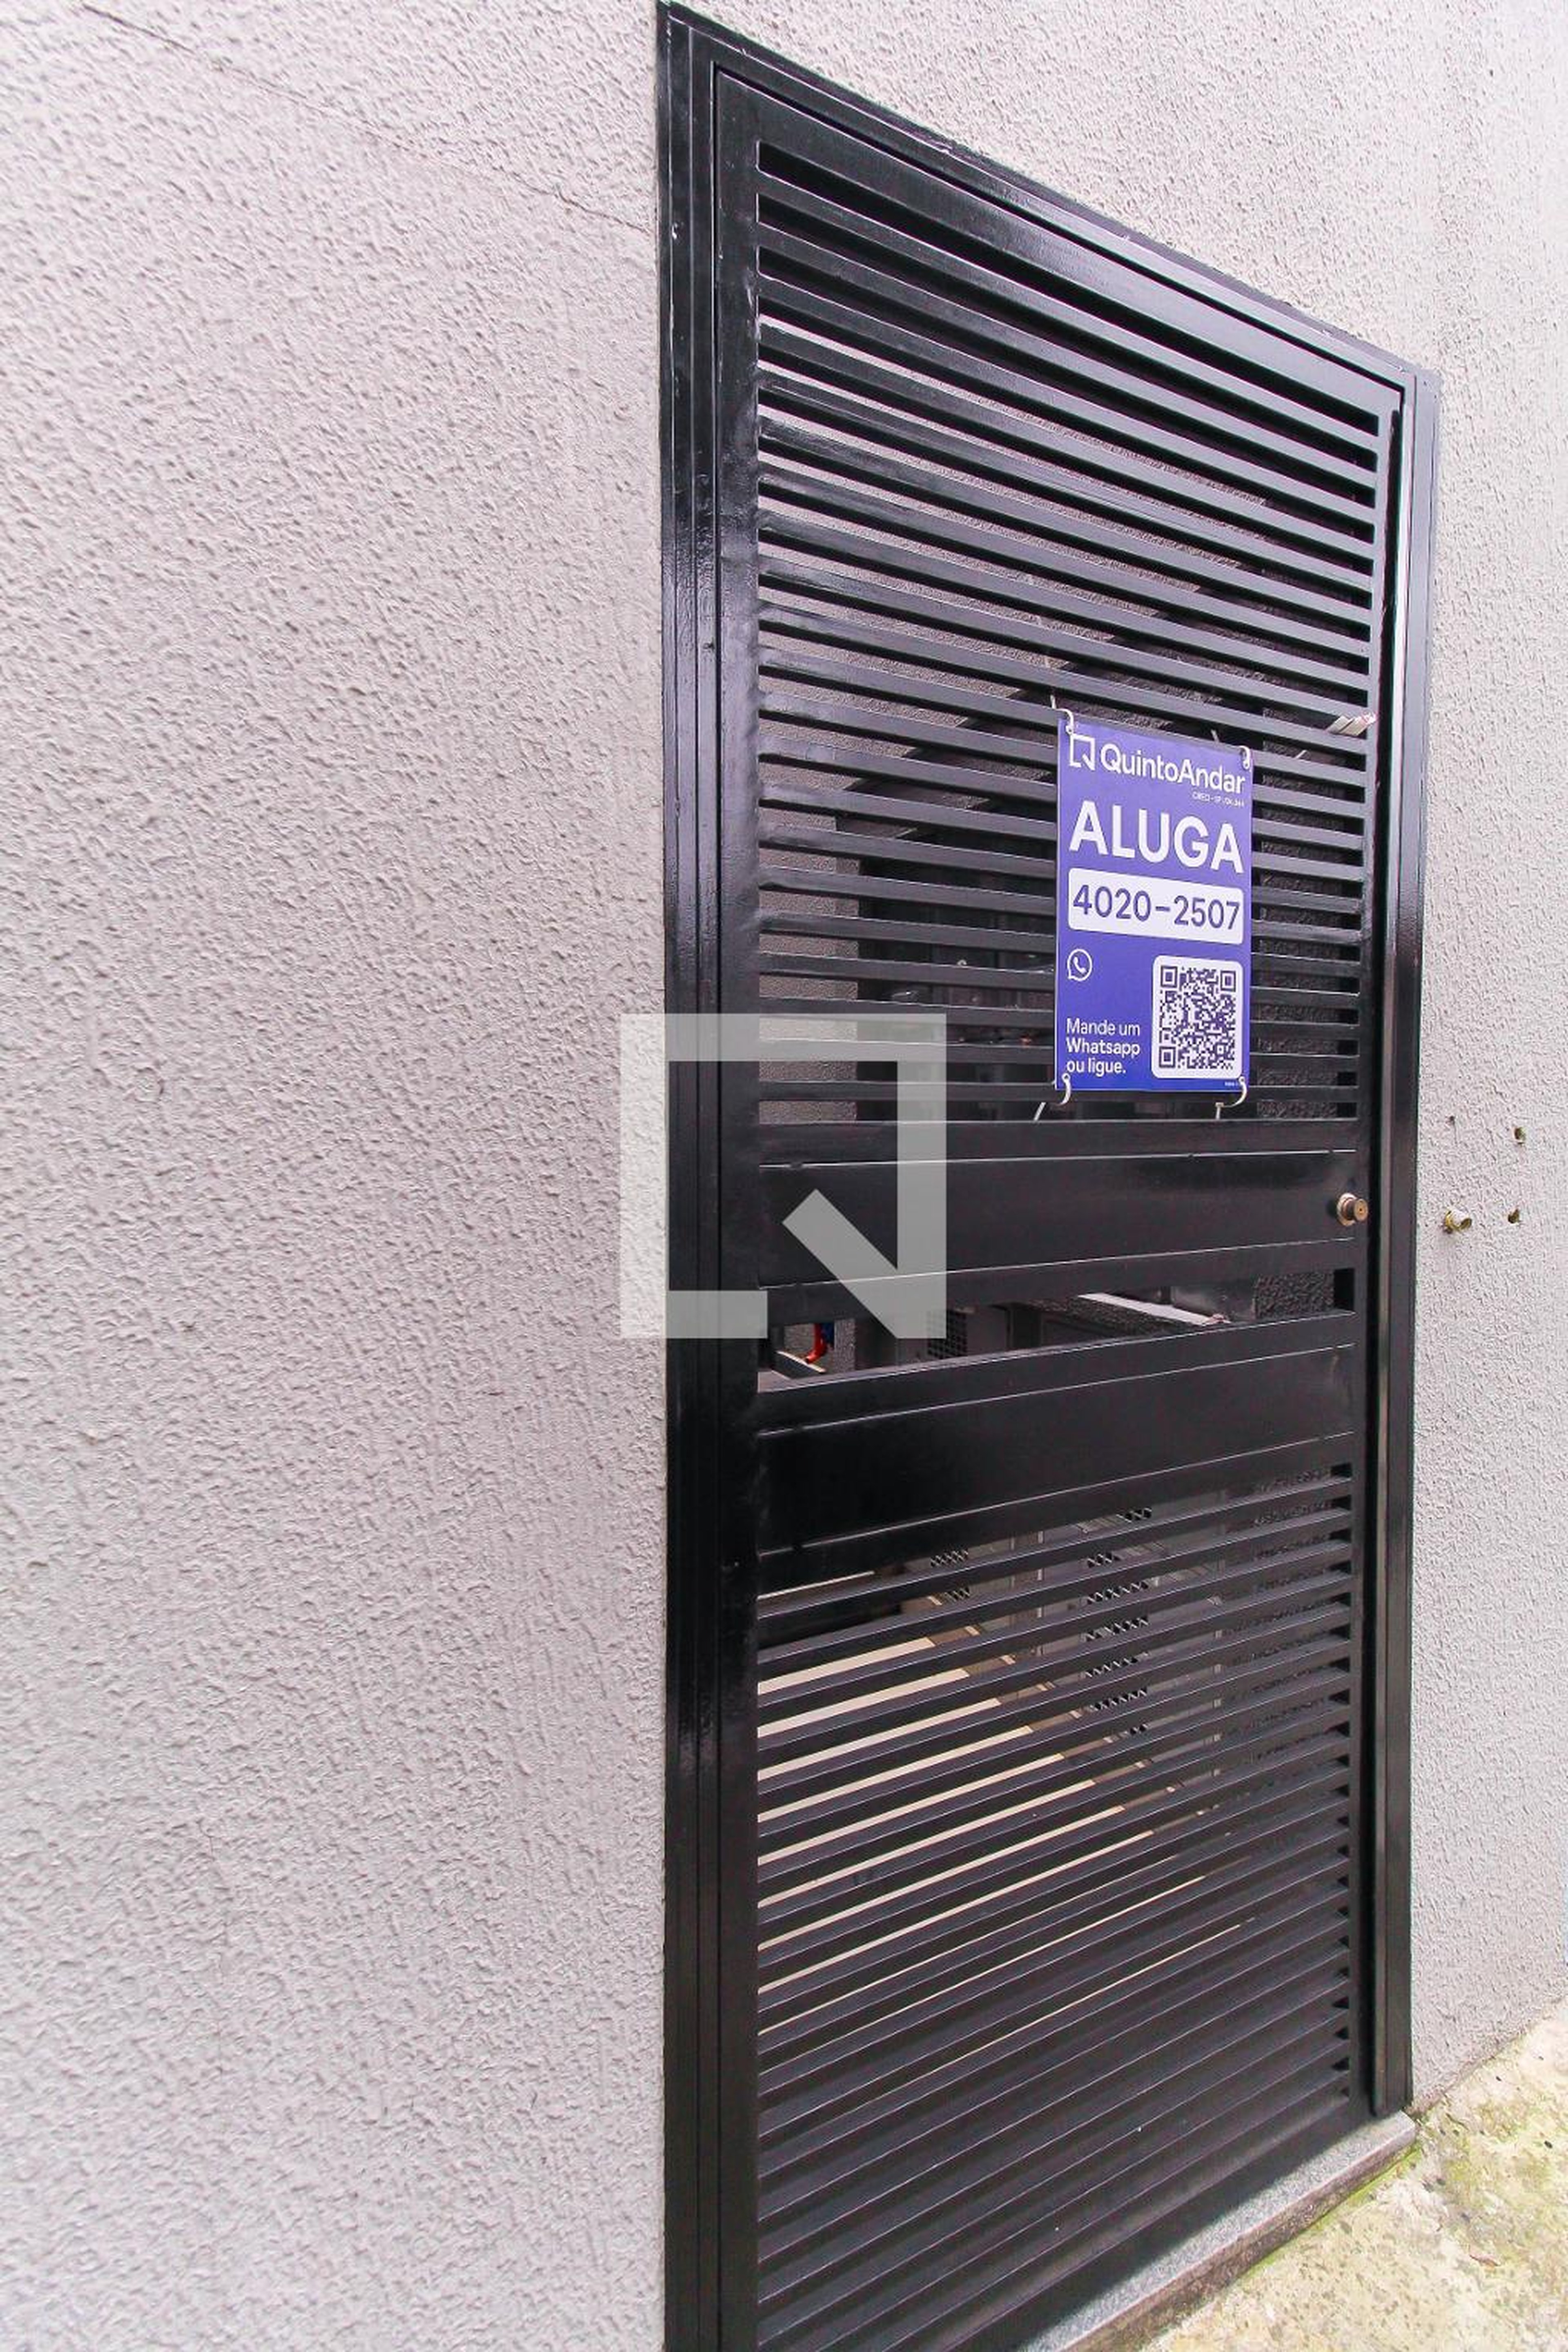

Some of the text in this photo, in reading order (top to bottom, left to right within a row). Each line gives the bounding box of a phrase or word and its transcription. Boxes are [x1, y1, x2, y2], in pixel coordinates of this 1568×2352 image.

[1100, 743, 1246, 794] QuintoAndar
[1069, 800, 1244, 873] ALUGA
[1073, 884, 1240, 930] 4020-2507
[1067, 1018, 1140, 1036] Mande um
[1066, 1037, 1140, 1058] Whatsapp
[1067, 1057, 1126, 1077] ou ligue.
